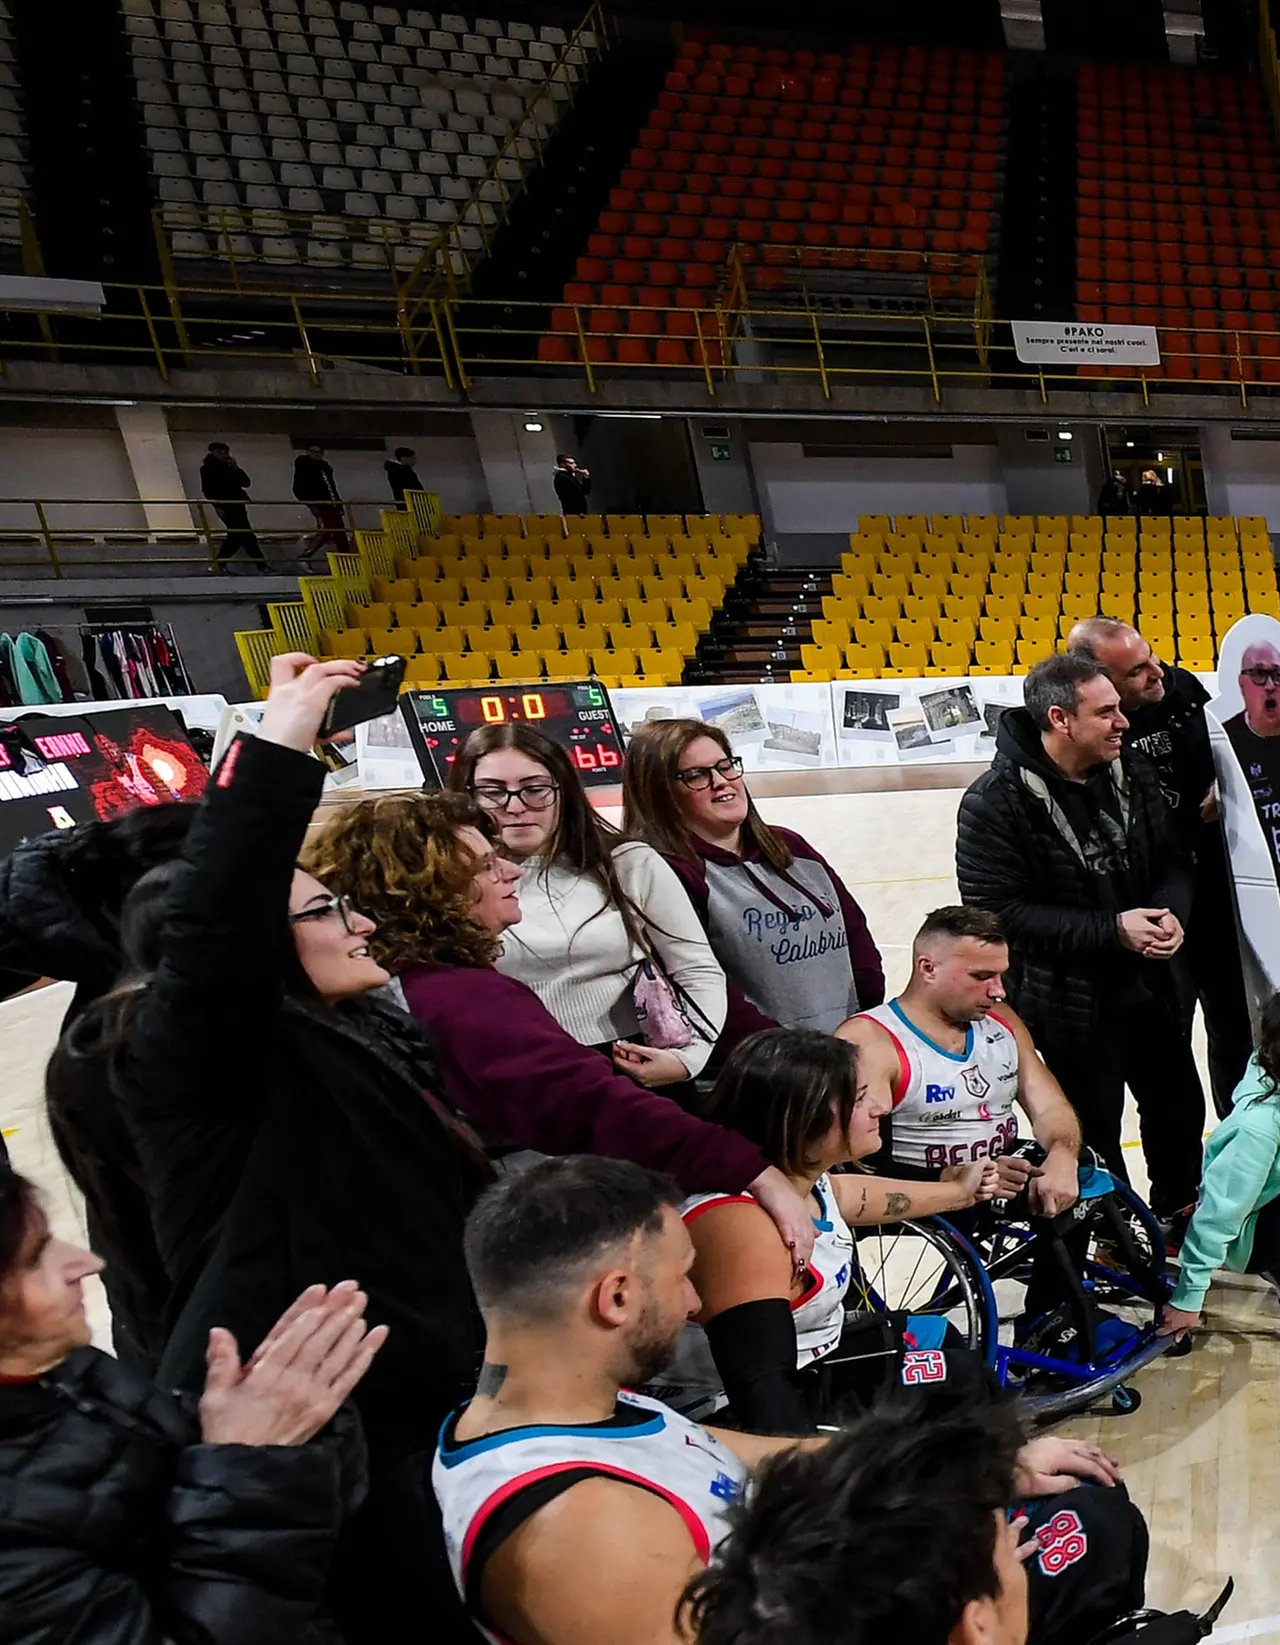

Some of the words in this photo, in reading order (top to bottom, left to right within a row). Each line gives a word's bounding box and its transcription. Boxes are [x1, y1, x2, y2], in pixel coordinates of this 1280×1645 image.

[1064, 327, 1104, 337] #PAKO
[1026, 337, 1054, 345] Sempre
[1056, 338, 1089, 346] presente
[481, 693, 546, 722] 0:0
[578, 709, 608, 721] GUEST
[420, 720, 456, 733] HOME
[1033, 1509, 1089, 1576] 88
